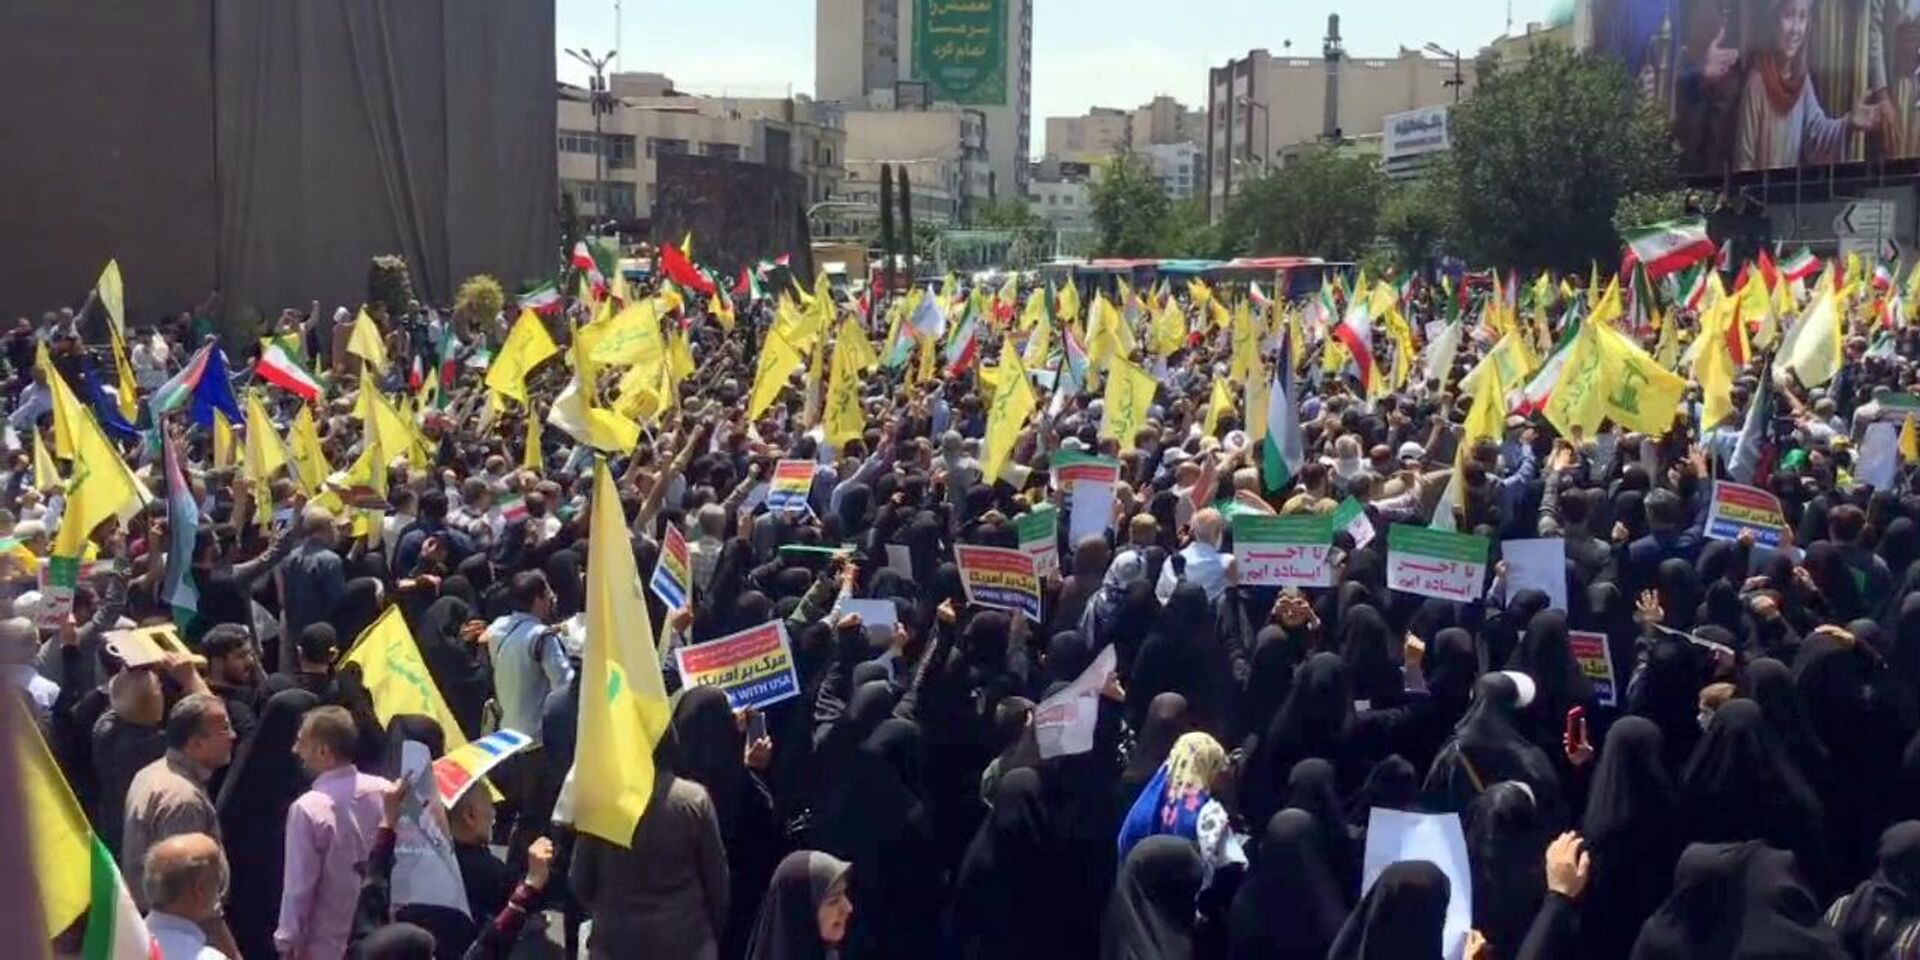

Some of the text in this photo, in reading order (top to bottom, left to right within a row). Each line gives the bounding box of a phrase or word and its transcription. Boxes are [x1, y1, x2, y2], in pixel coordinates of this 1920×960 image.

[1273, 563, 1321, 579] ایستاده
[1464, 562, 1476, 578] تا
[1424, 578, 1472, 597] ایستاده
[737, 681, 769, 700] WITH
[768, 673, 793, 690] USA
